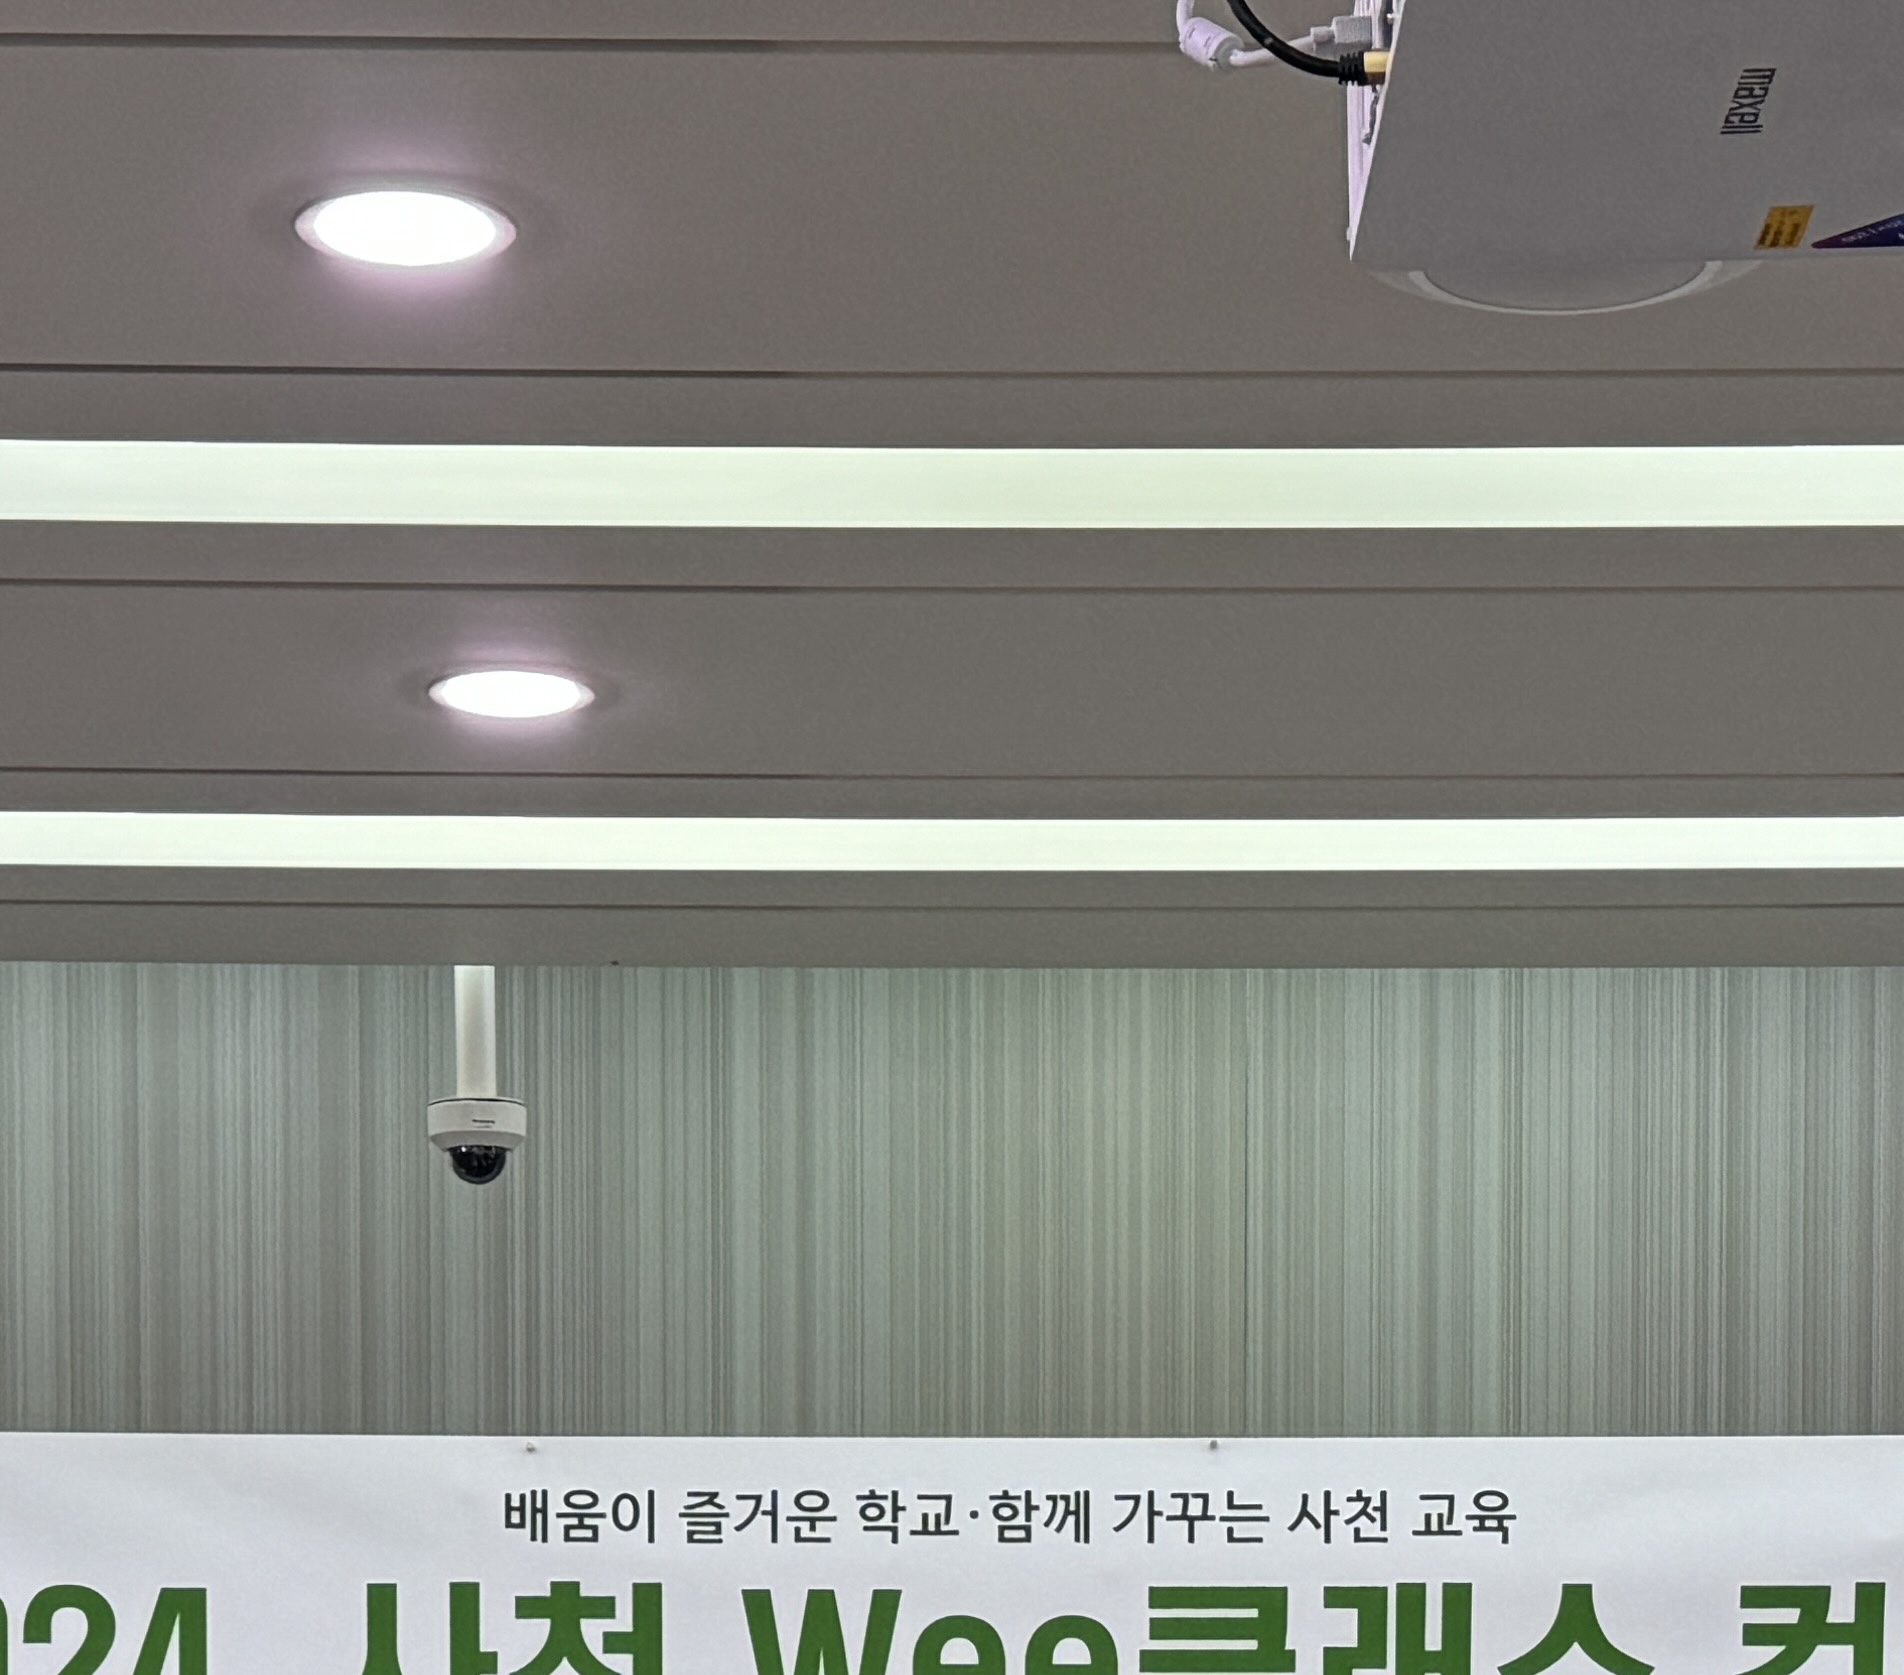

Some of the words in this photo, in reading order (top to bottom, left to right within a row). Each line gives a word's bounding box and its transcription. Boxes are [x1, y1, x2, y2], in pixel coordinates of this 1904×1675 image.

[1721, 67, 1775, 136] maxell
[503, 1488, 655, 1544] 배움이
[677, 1489, 838, 1544] 즐거운
[855, 1489, 1090, 1545] 학교·함께
[1112, 1489, 1270, 1544] 가꾸는
[1287, 1489, 1389, 1544] 사천
[1412, 1490, 1517, 1545] 교육
